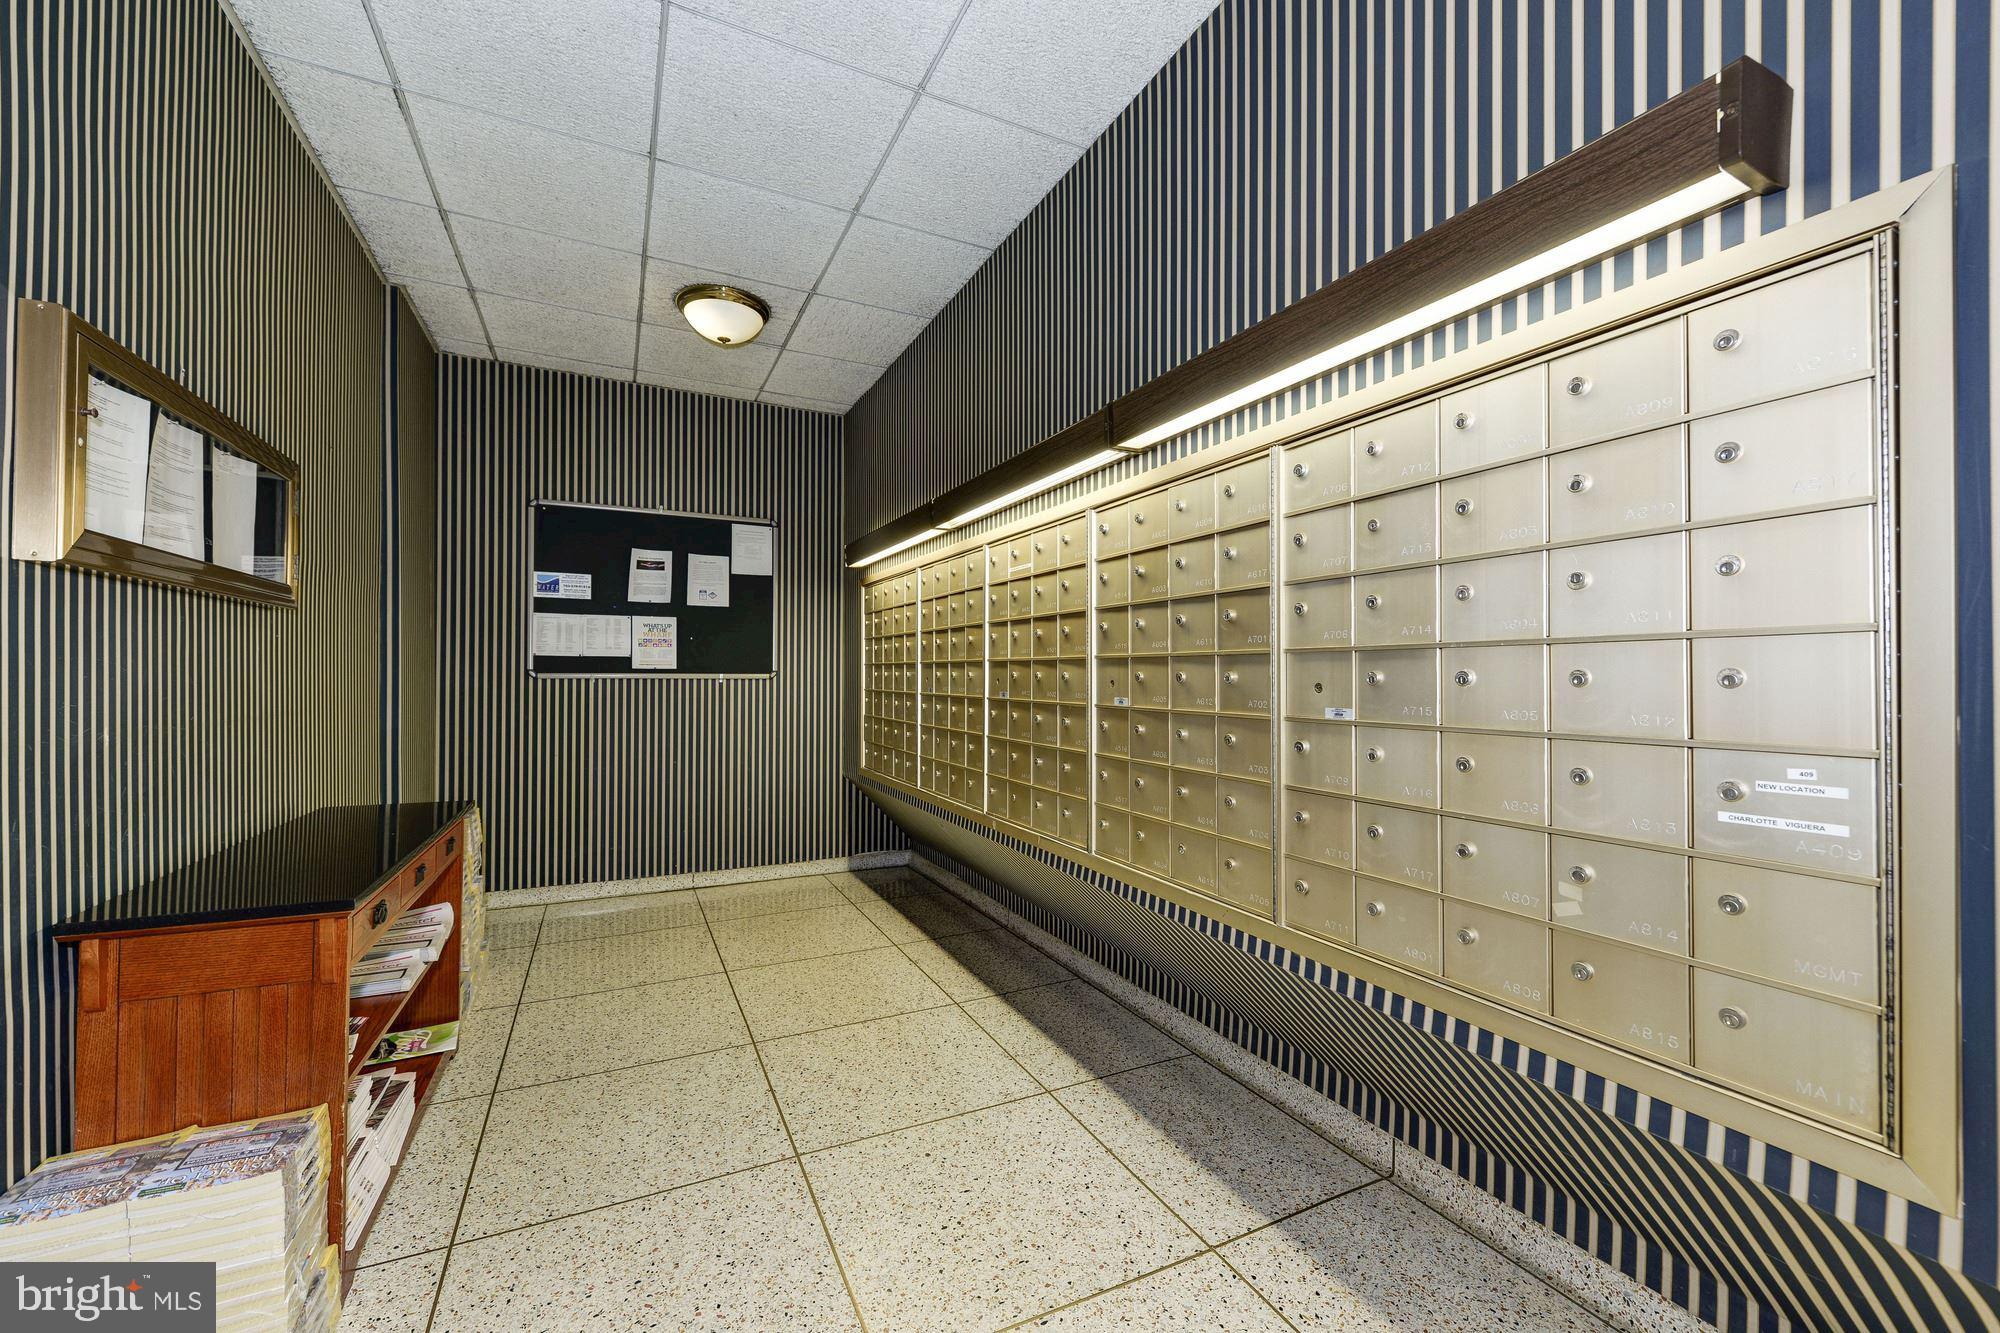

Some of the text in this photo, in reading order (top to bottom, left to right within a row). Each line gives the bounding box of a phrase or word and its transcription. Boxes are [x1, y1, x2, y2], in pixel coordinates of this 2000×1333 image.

[1624, 397, 1674, 417] A809
[1402, 463, 1431, 476] A712
[1401, 544, 1432, 556] A713
[1322, 556, 1348, 569] A707
[1625, 609, 1672, 623] A811
[1401, 625, 1432, 636] A714
[1247, 635, 1267, 643] A701
[1248, 700, 1268, 708] A702
[1402, 706, 1432, 717] A715
[1503, 710, 1538, 722] A805
[1630, 714, 1675, 728] A812
[1248, 765, 1268, 774] A703
[1757, 783, 1826, 795] NEW LOCATION
[1728, 814, 1826, 832] CHARLOTTE VIGUERA
[1324, 848, 1350, 861] A710
[1403, 866, 1433, 882] A717
[1249, 894, 1269, 906] A705
[1502, 891, 1540, 908] A807
[1629, 921, 1679, 942] A814
[1403, 947, 1433, 962] A801
[1794, 959, 1864, 988] MGMT
[1503, 981, 1541, 1002] A808
[1630, 1024, 1679, 1049] A815
[1795, 1079, 1865, 1115] MAIN
